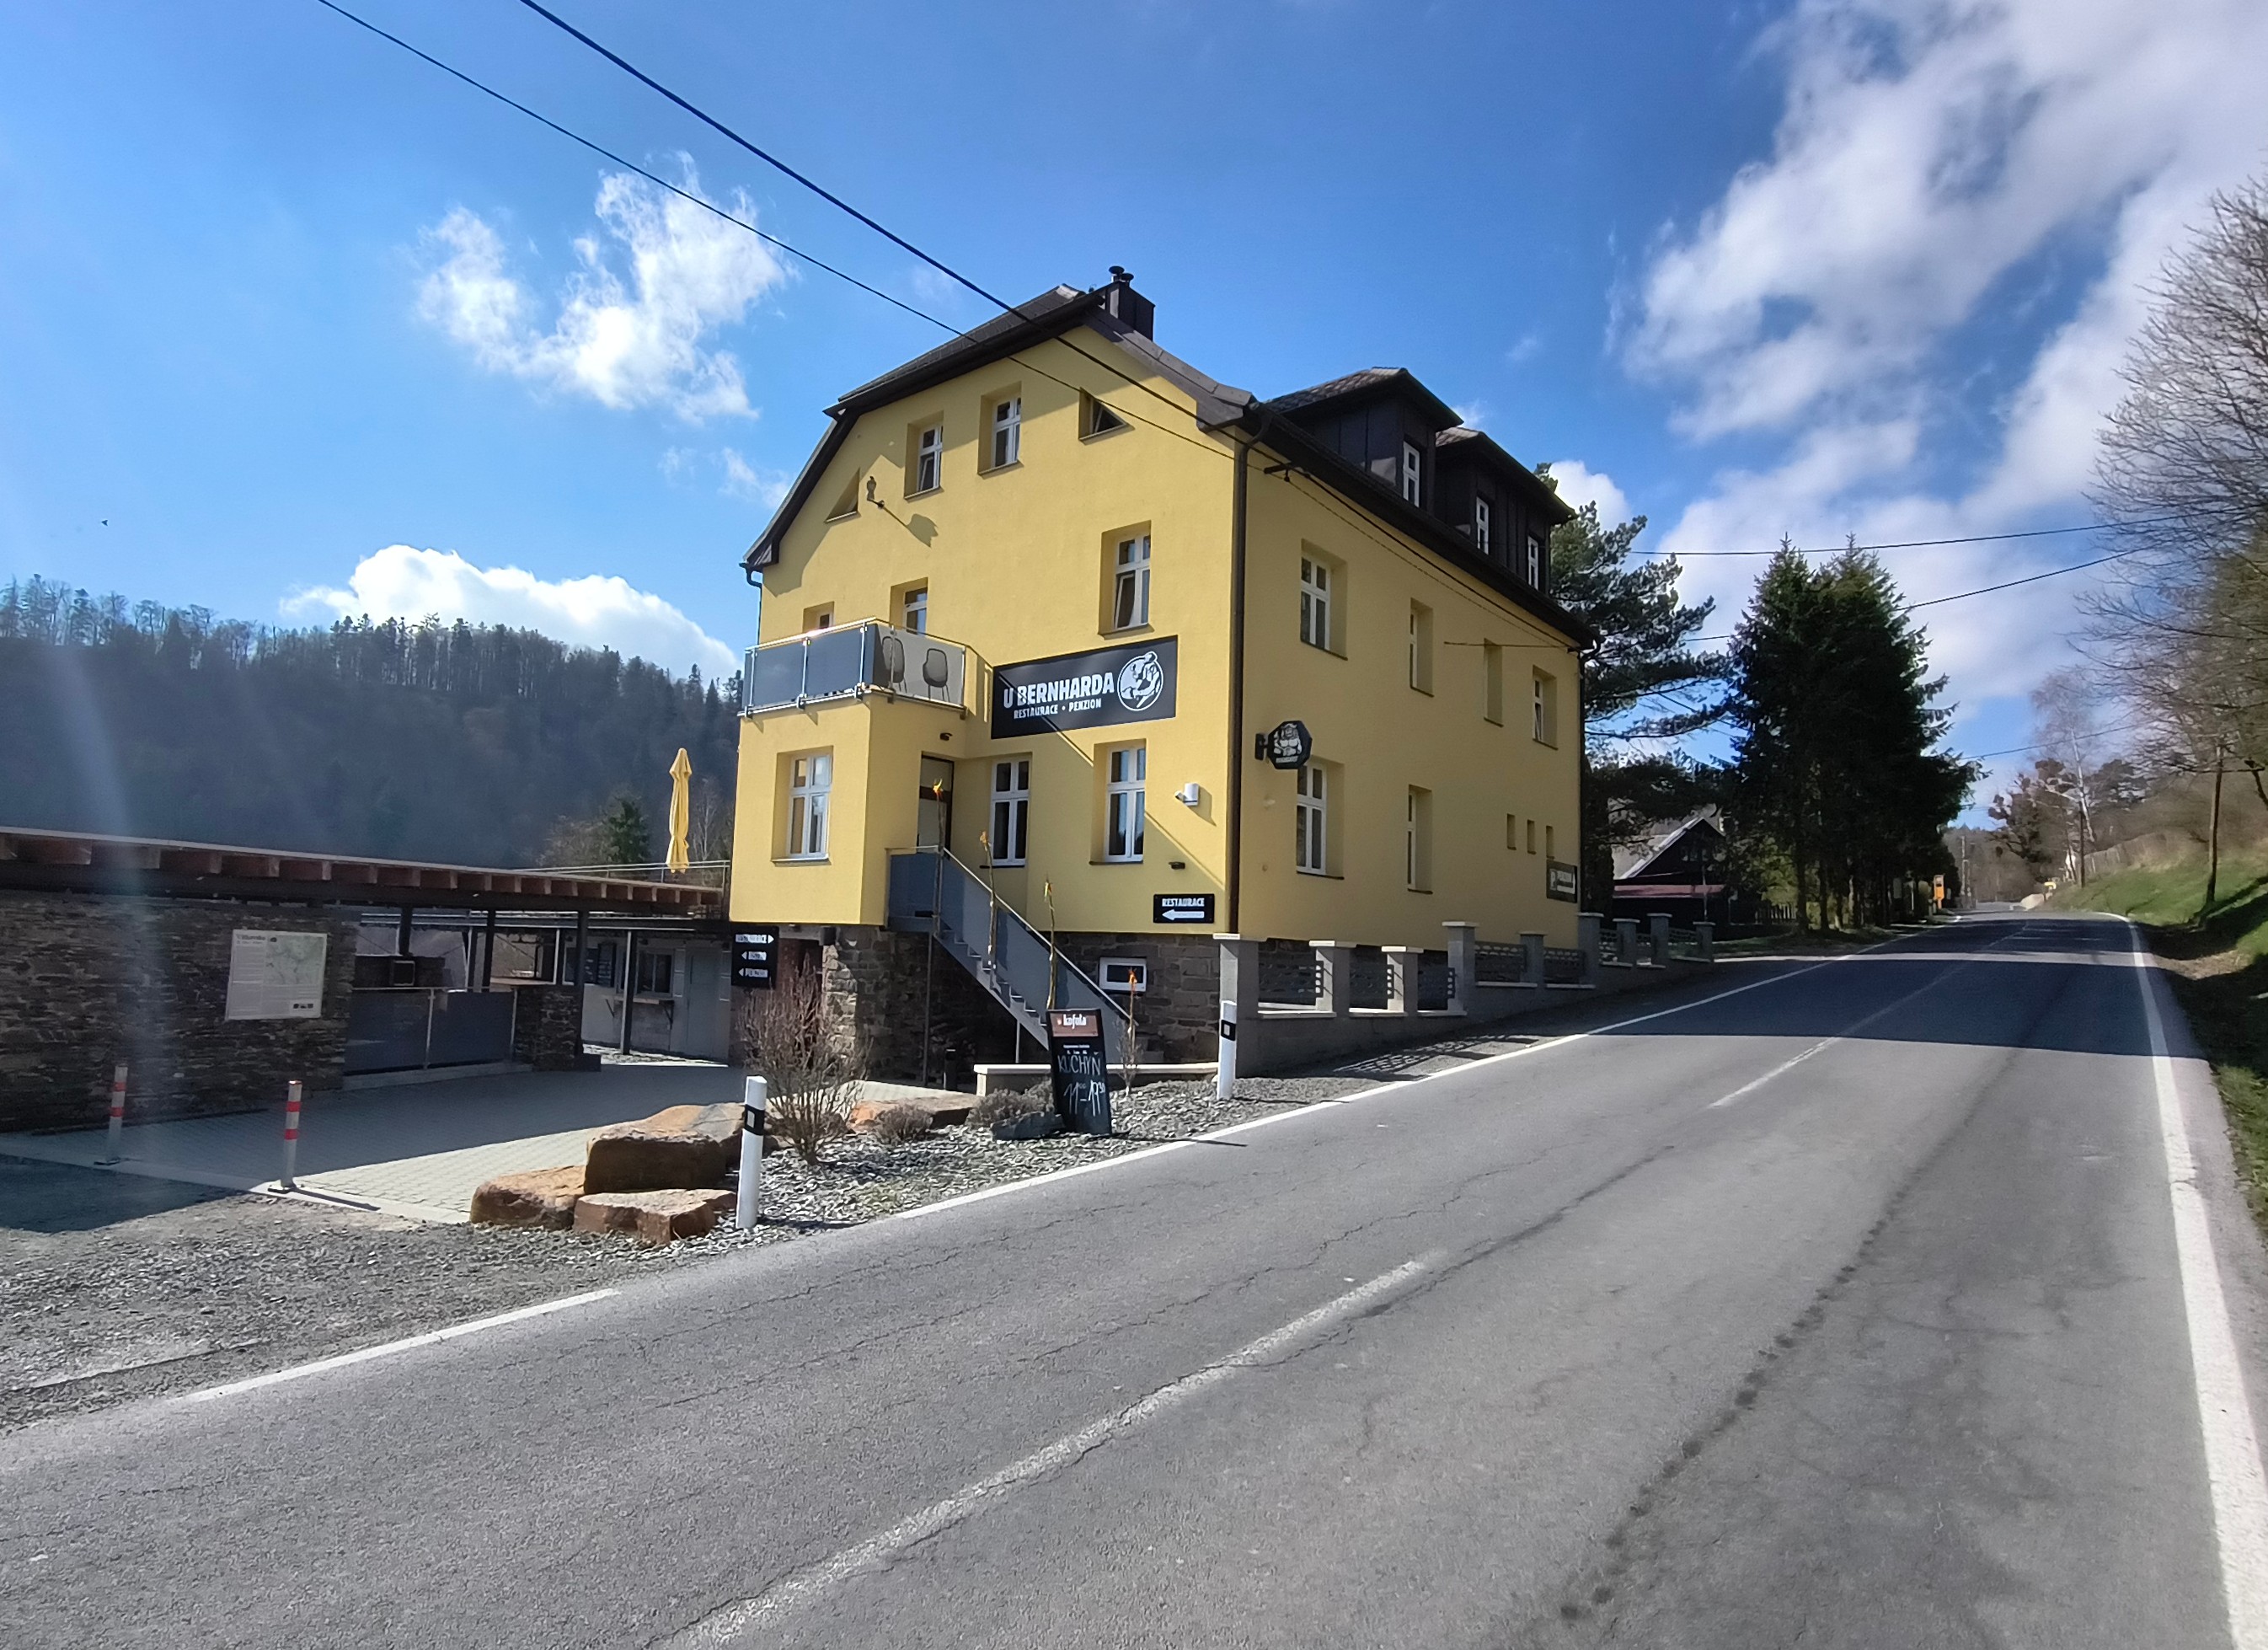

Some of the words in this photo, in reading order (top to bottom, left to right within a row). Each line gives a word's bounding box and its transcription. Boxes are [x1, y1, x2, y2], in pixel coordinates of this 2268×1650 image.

[1003, 687, 1014, 709] U
[1017, 672, 1115, 706] BERNHARDA
[1014, 704, 1058, 719] RESTAURACE
[1068, 698, 1102, 712] PENZION
[1162, 897, 1205, 907] RESTAURACE
